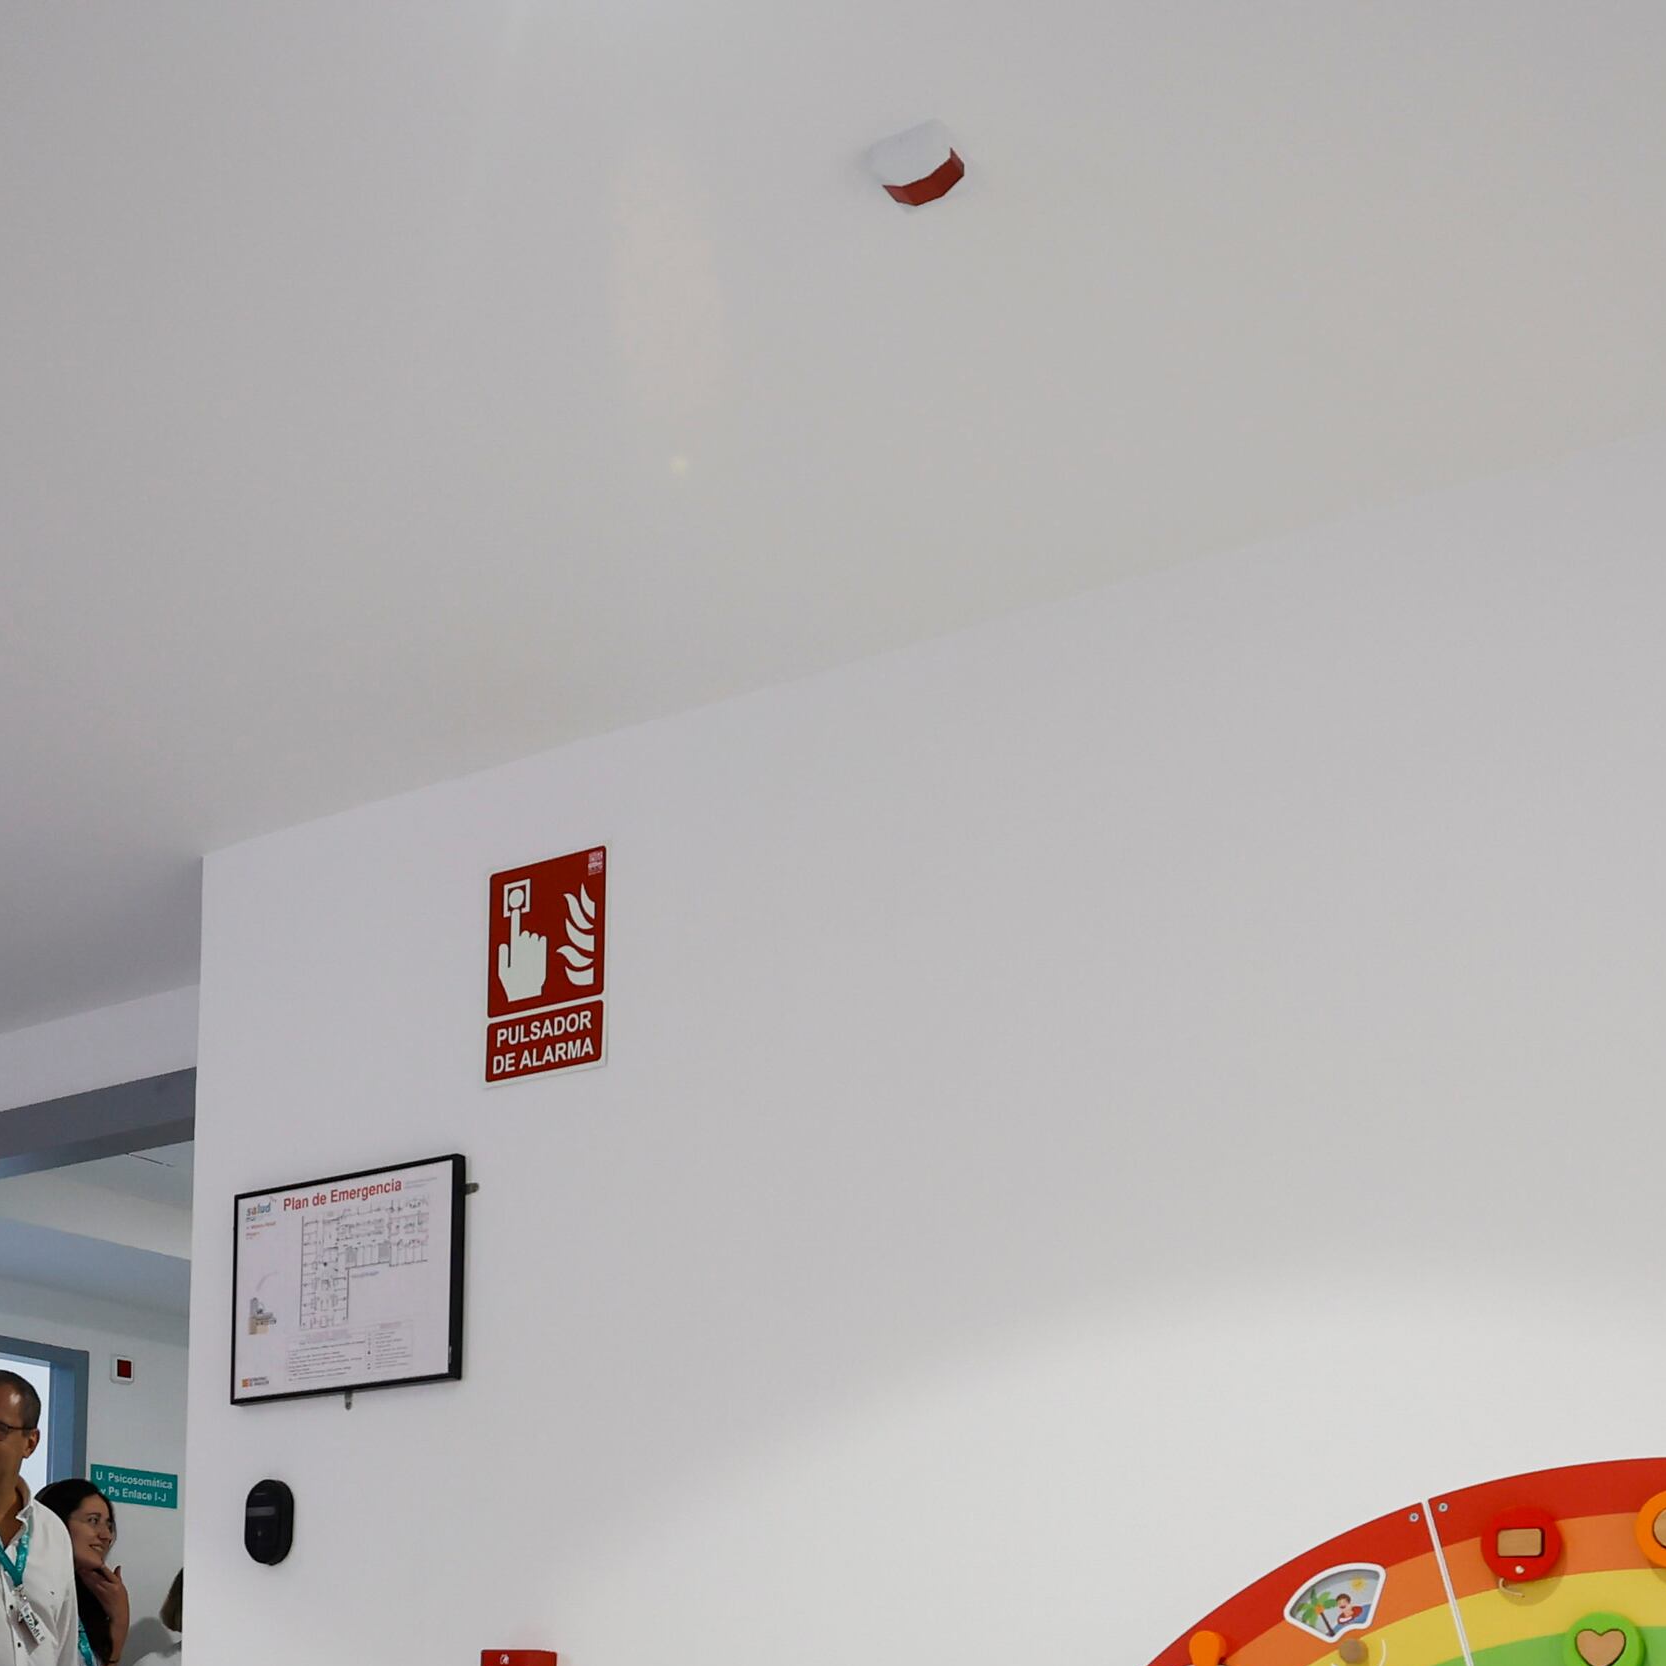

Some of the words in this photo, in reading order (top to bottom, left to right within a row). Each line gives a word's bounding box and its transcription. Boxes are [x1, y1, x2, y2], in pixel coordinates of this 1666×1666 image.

[497, 1010, 592, 1048] PULSADOR
[493, 1052, 516, 1075] DE
[519, 1037, 594, 1070] ALARMA
[283, 1197, 309, 1211] Plan
[312, 1192, 327, 1207] de
[331, 1178, 402, 1201] Emergencia
[122, 1488, 152, 1501] Enlace
